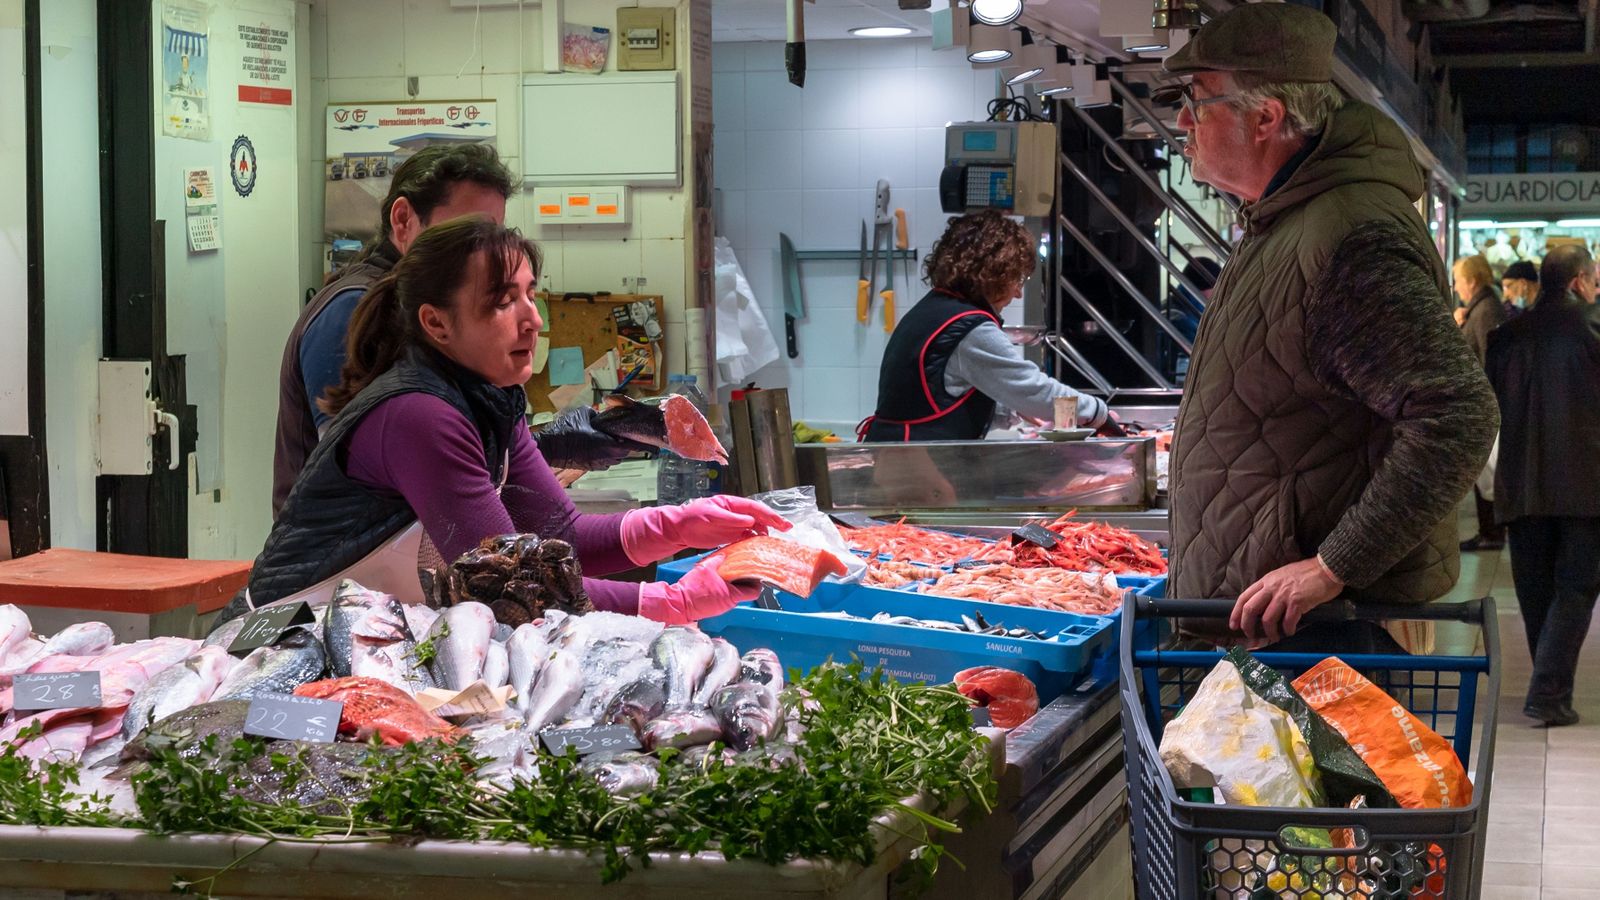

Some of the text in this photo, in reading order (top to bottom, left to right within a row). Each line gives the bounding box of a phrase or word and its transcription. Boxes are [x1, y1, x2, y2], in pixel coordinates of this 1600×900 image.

[1466, 180, 1600, 203] GUARDIOLA
[858, 644, 911, 657] LONJA PESQUERA
[32, 684, 76, 702] 28
[248, 707, 288, 736] 22
